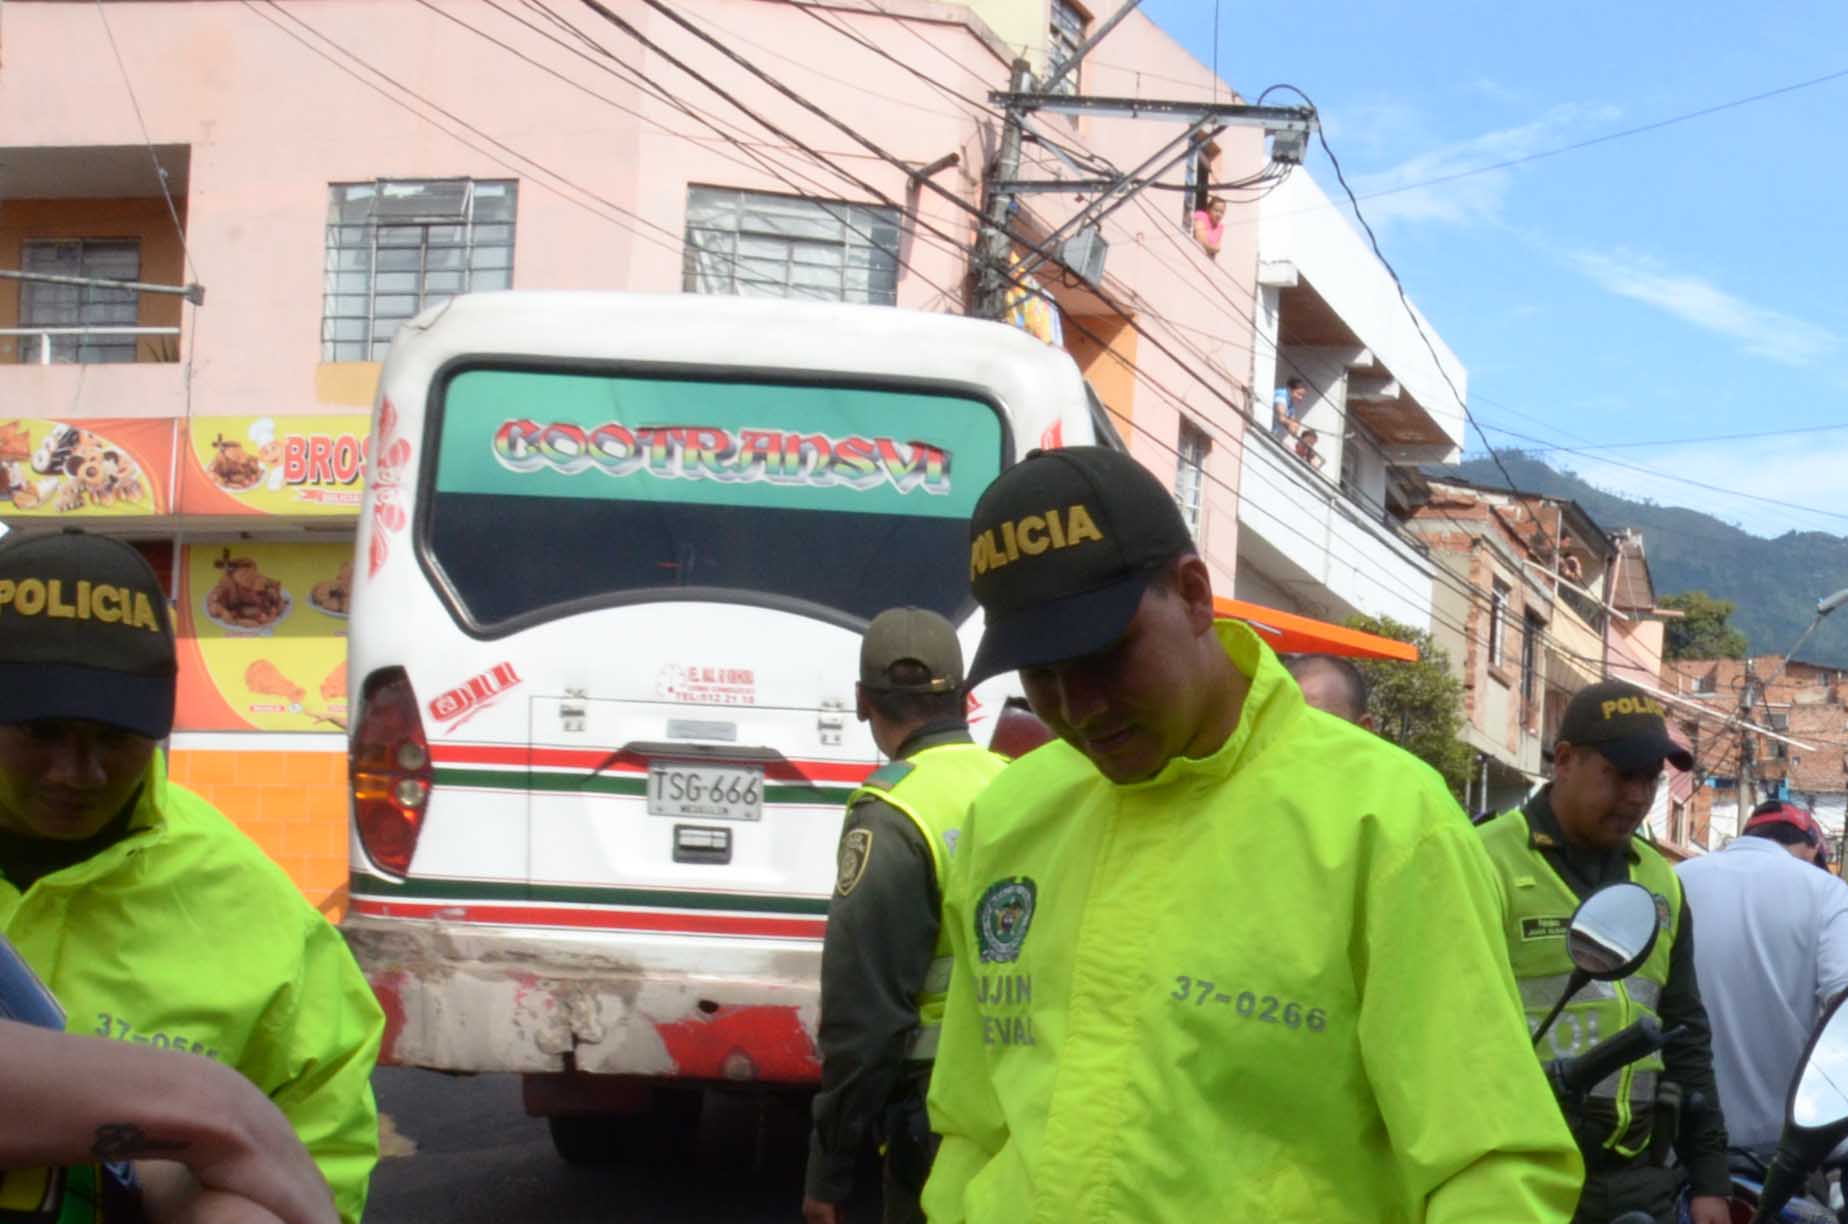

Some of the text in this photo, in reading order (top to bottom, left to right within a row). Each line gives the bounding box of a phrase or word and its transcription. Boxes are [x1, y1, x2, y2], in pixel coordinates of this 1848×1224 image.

[0, 578, 160, 632] POLICIA
[652, 770, 760, 806] TSG-666
[1169, 974, 1329, 1033] 37-0266
